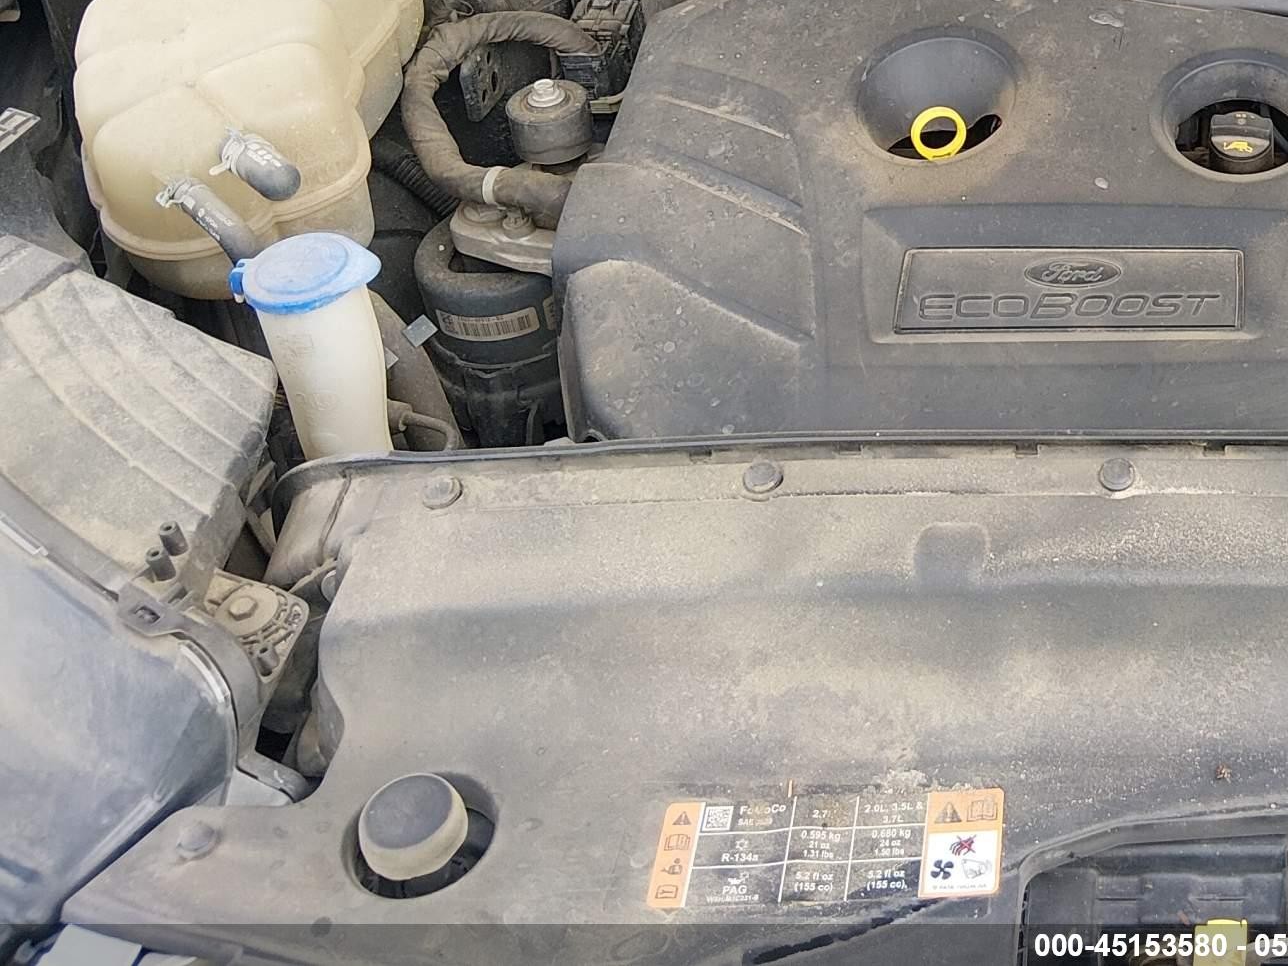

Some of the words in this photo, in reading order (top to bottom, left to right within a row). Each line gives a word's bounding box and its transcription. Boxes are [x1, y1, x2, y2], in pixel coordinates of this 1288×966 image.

[1041, 261, 1104, 284] Ford
[919, 292, 1221, 321] ECOBOOST
[828, 830, 841, 843] kg
[899, 828, 911, 839] kg
[721, 852, 759, 863] R-134a
[721, 884, 748, 895] PAG
[793, 881, 817, 893] (155
[866, 879, 889, 892] (155
